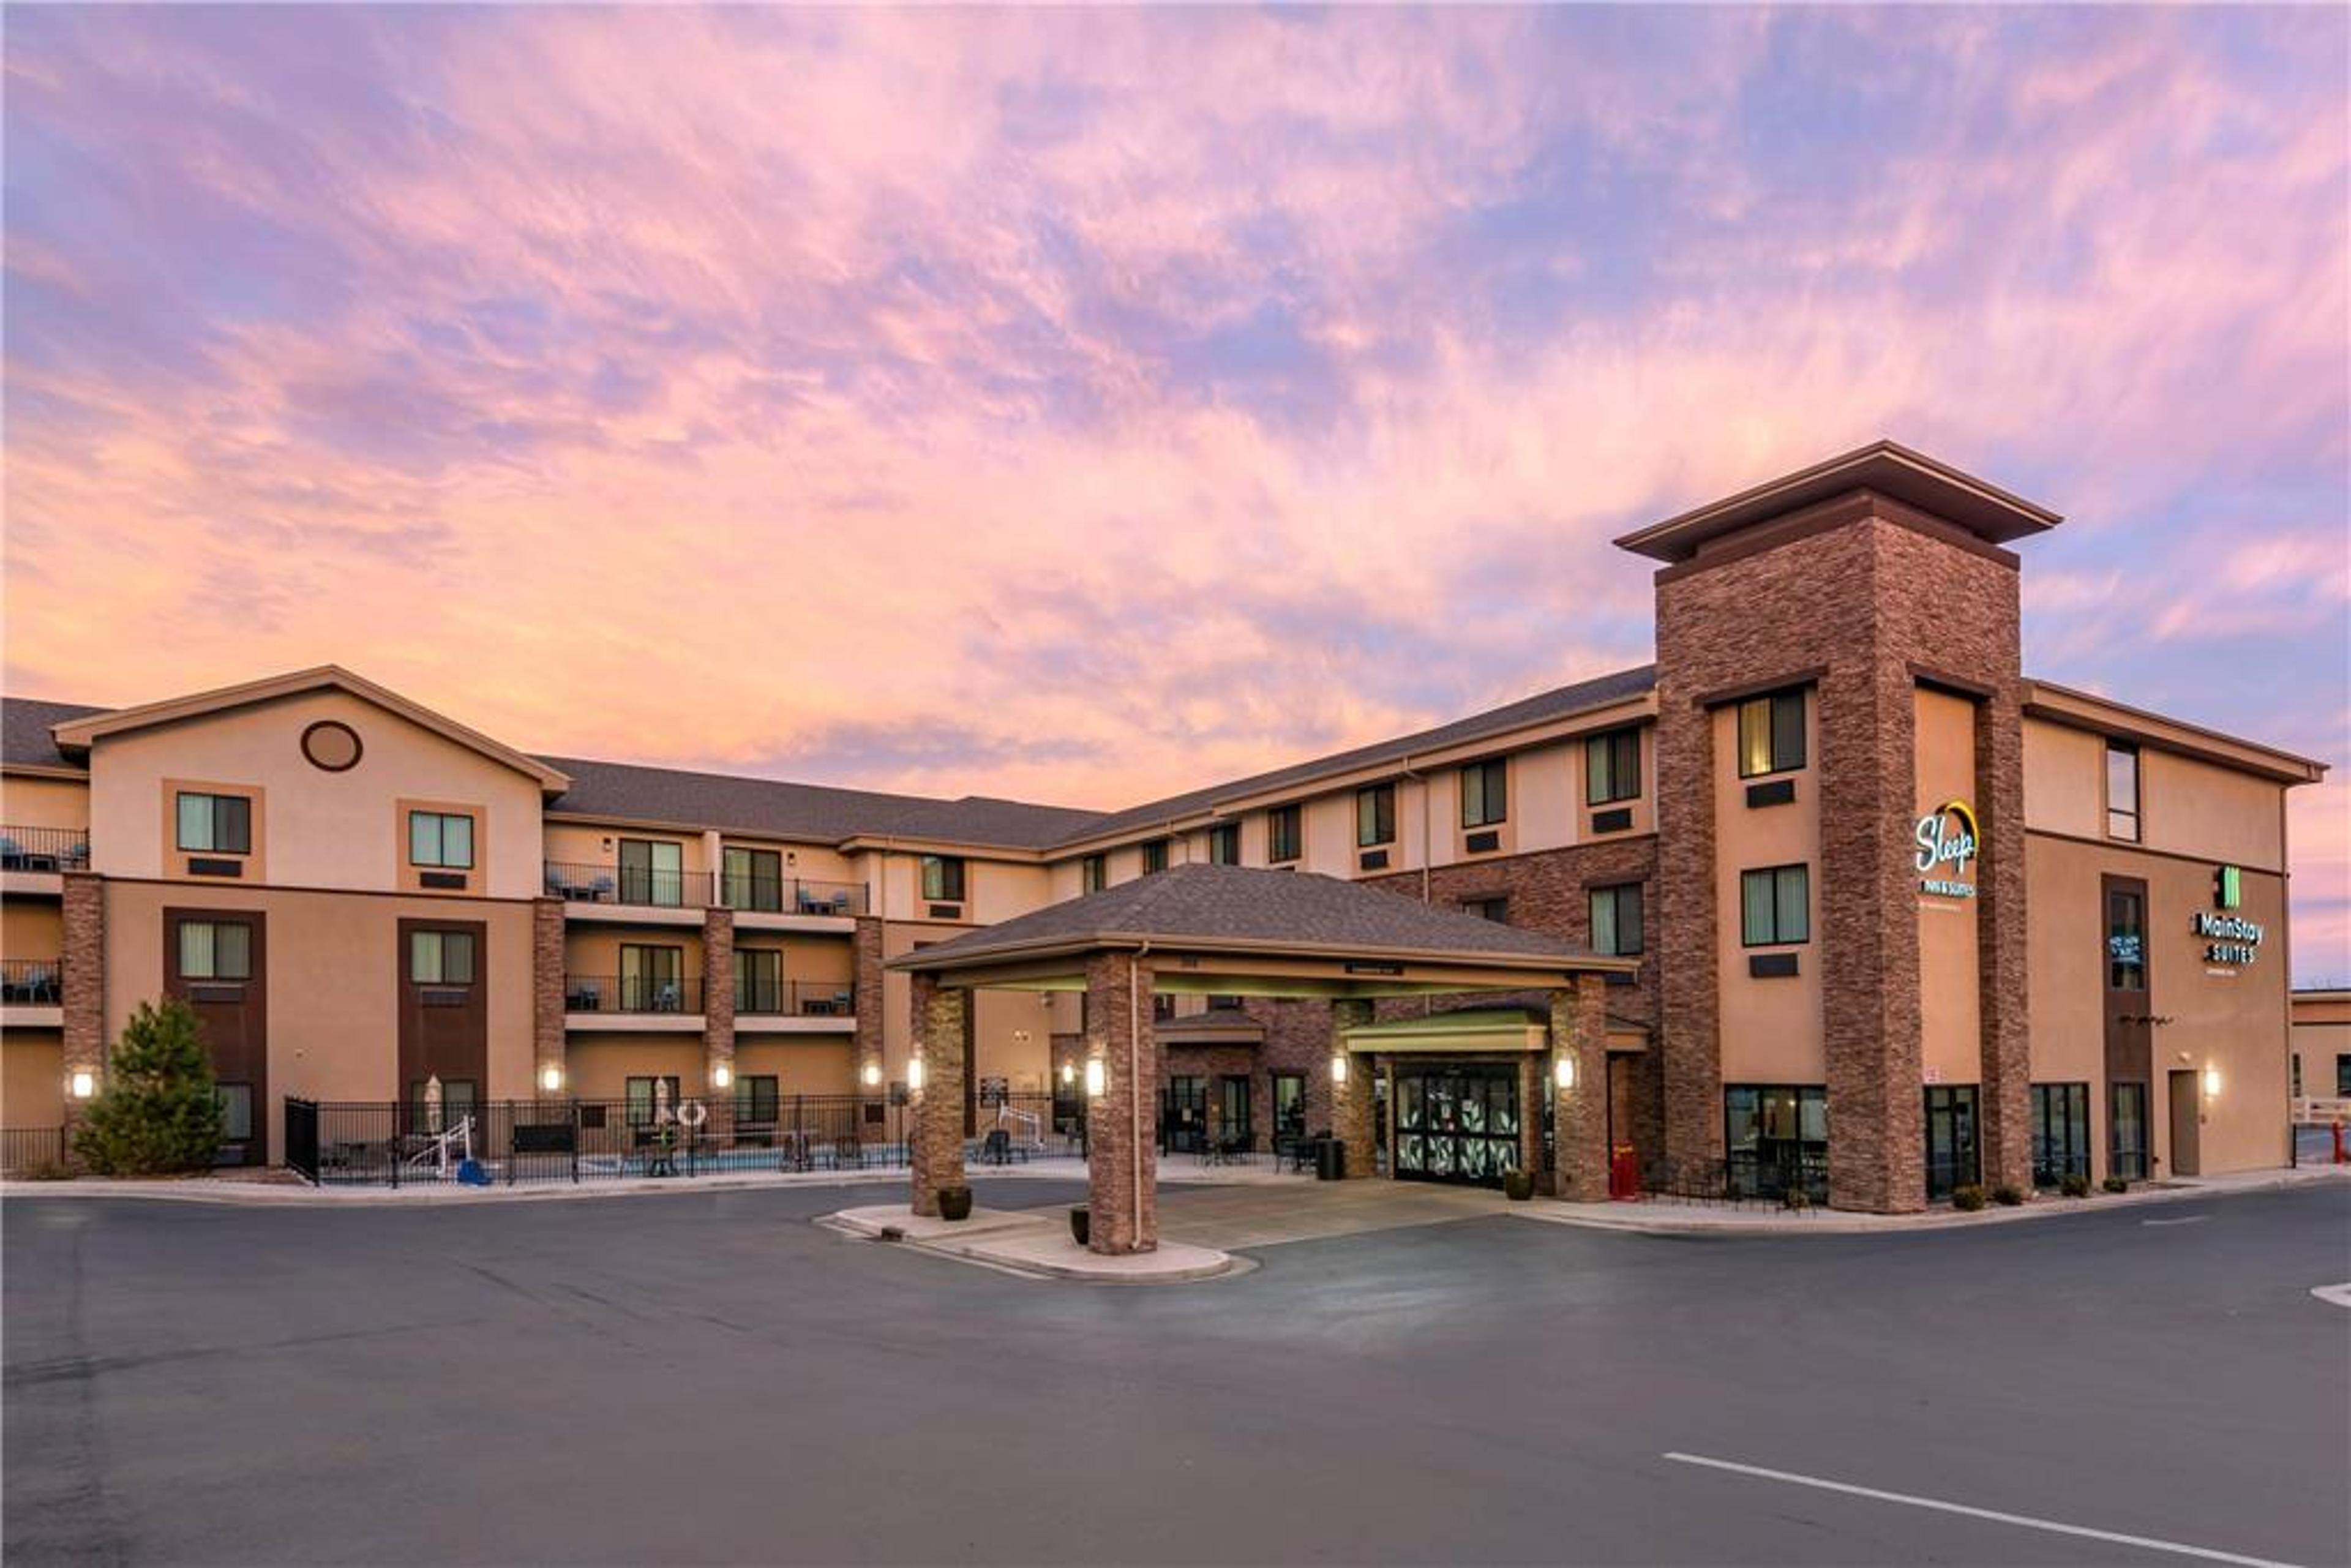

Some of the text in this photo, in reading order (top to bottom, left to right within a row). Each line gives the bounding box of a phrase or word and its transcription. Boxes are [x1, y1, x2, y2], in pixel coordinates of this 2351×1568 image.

[1917, 816, 1974, 874] Sleep
[2201, 913, 2263, 945] MainStay
[2213, 945, 2255, 963] SUITES
